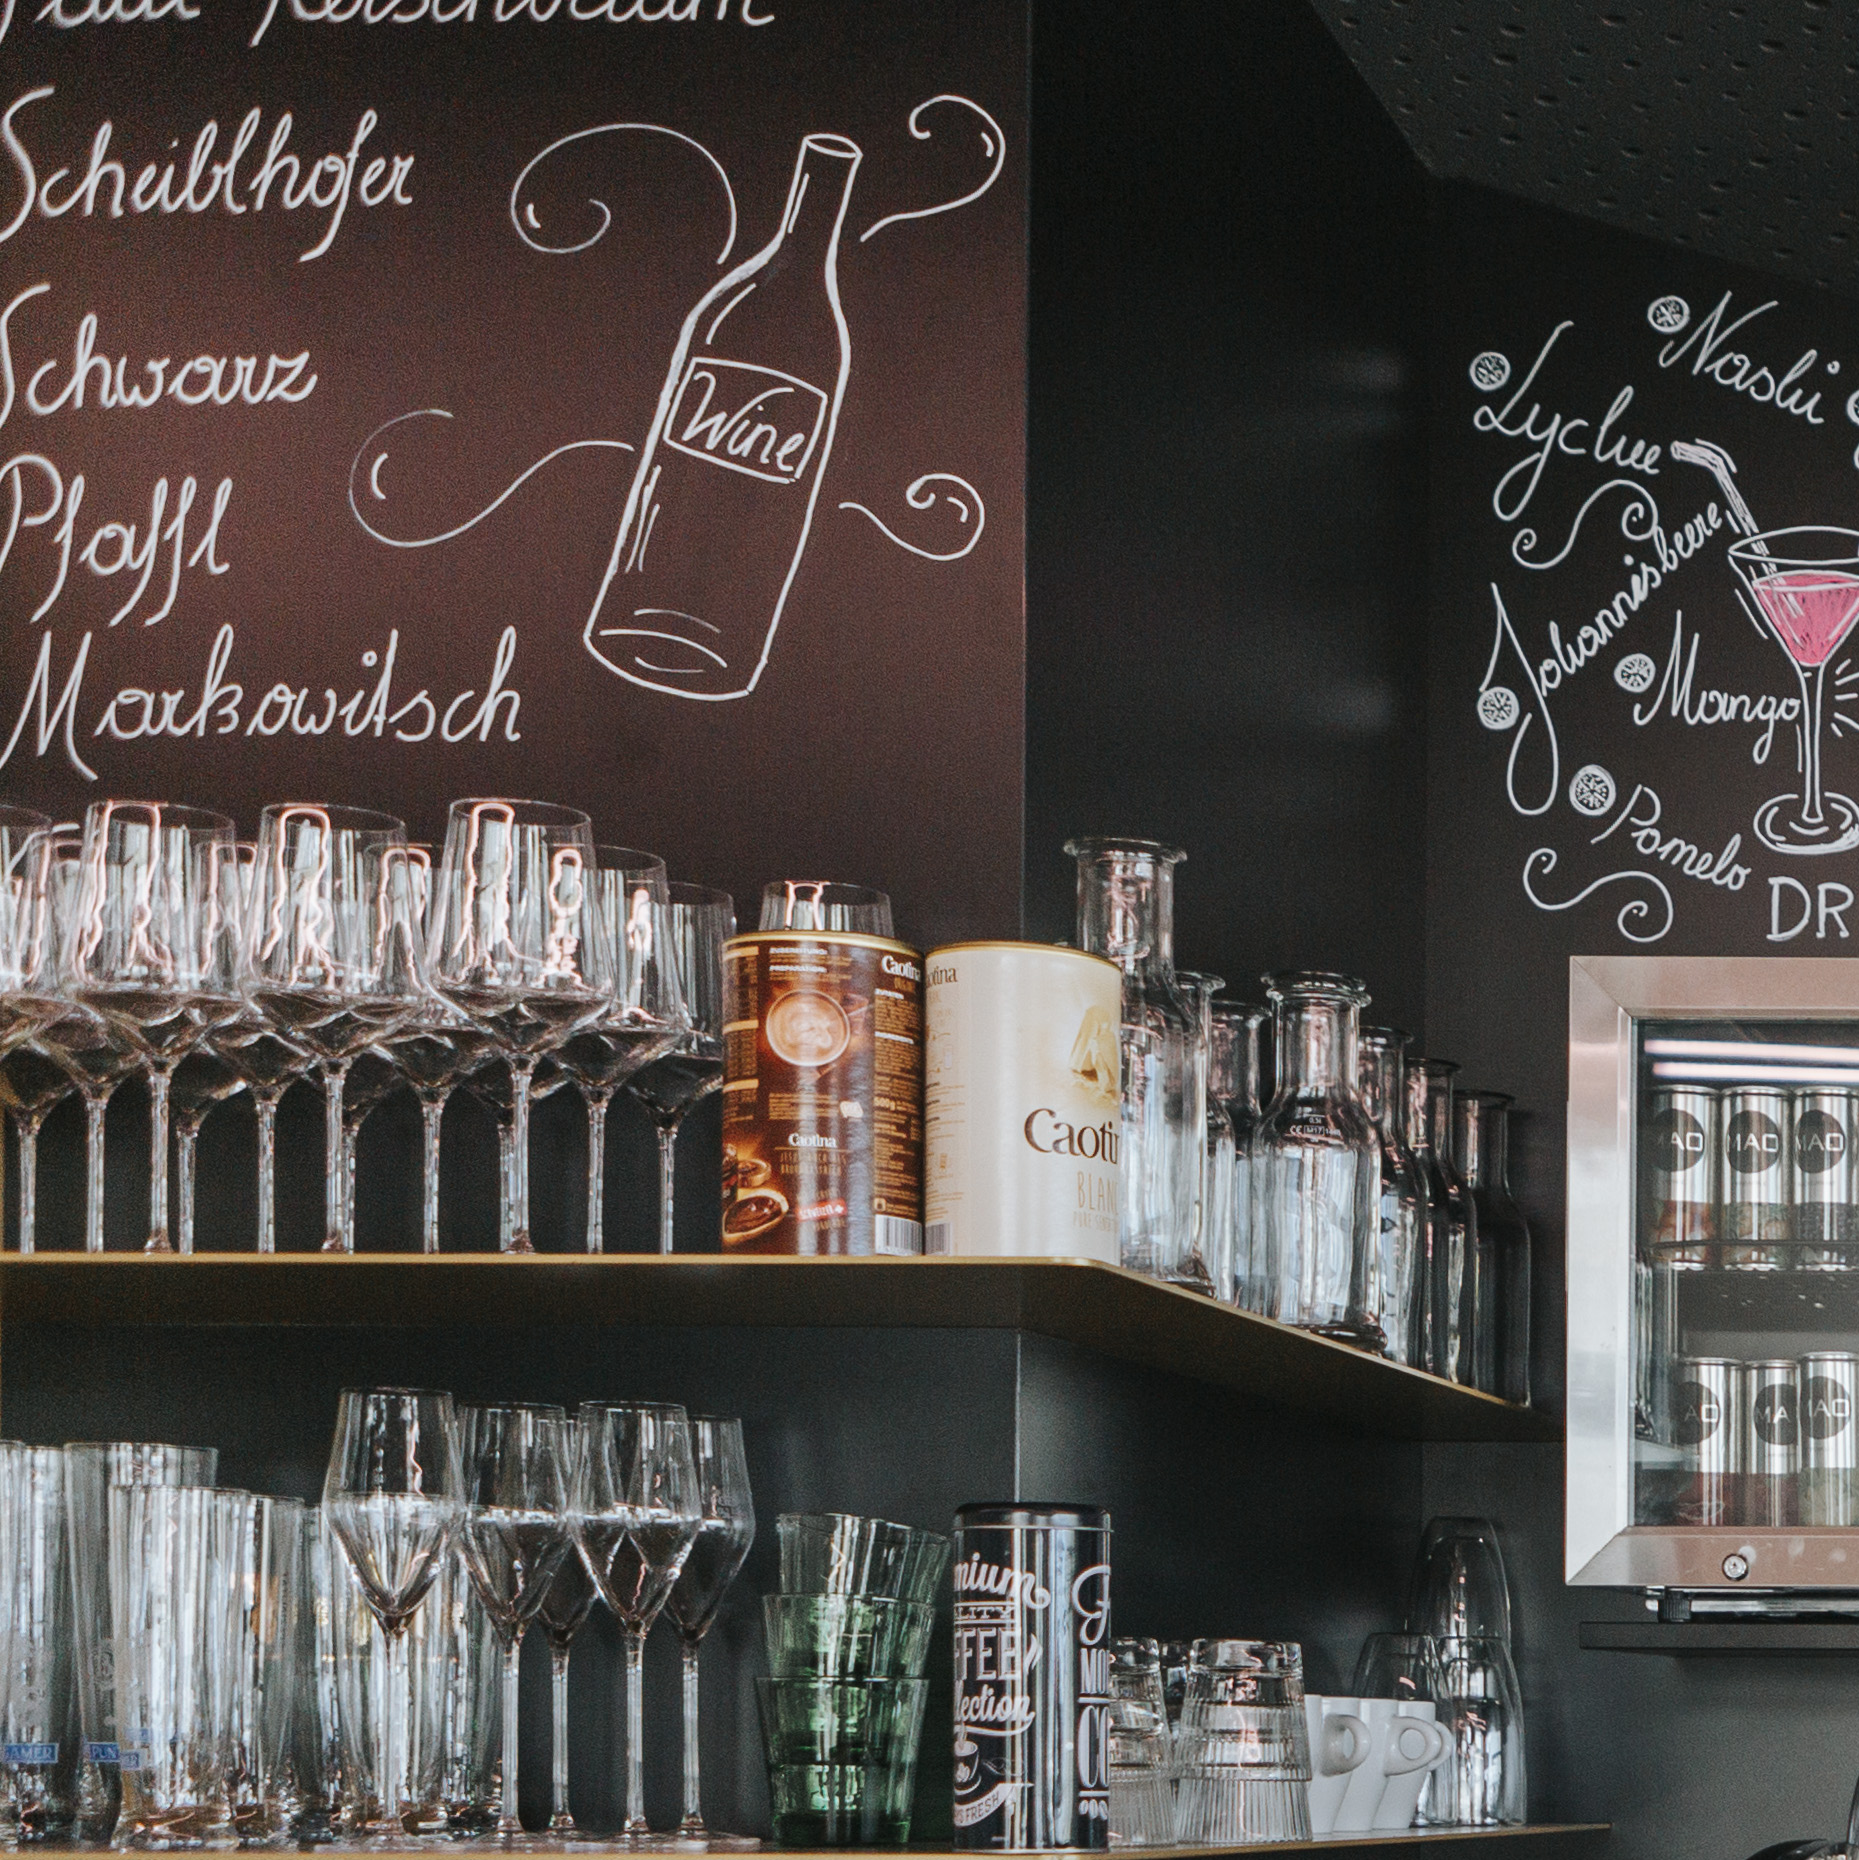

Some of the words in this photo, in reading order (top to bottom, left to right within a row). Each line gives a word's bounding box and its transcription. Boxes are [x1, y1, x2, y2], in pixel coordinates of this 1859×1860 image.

[0, 87, 416, 262] Scheiblhofer
[0, 284, 318, 426] Schwarz
[681, 370, 807, 474] Wine
[1473, 320, 1661, 521] Lychee
[1659, 290, 1840, 426] Nashi
[0, 625, 522, 781] Markowitsch
[1479, 500, 1724, 816] Johannisbeere
[1632, 608, 1802, 765] Mango
[1590, 783, 1752, 893] Pomelo
